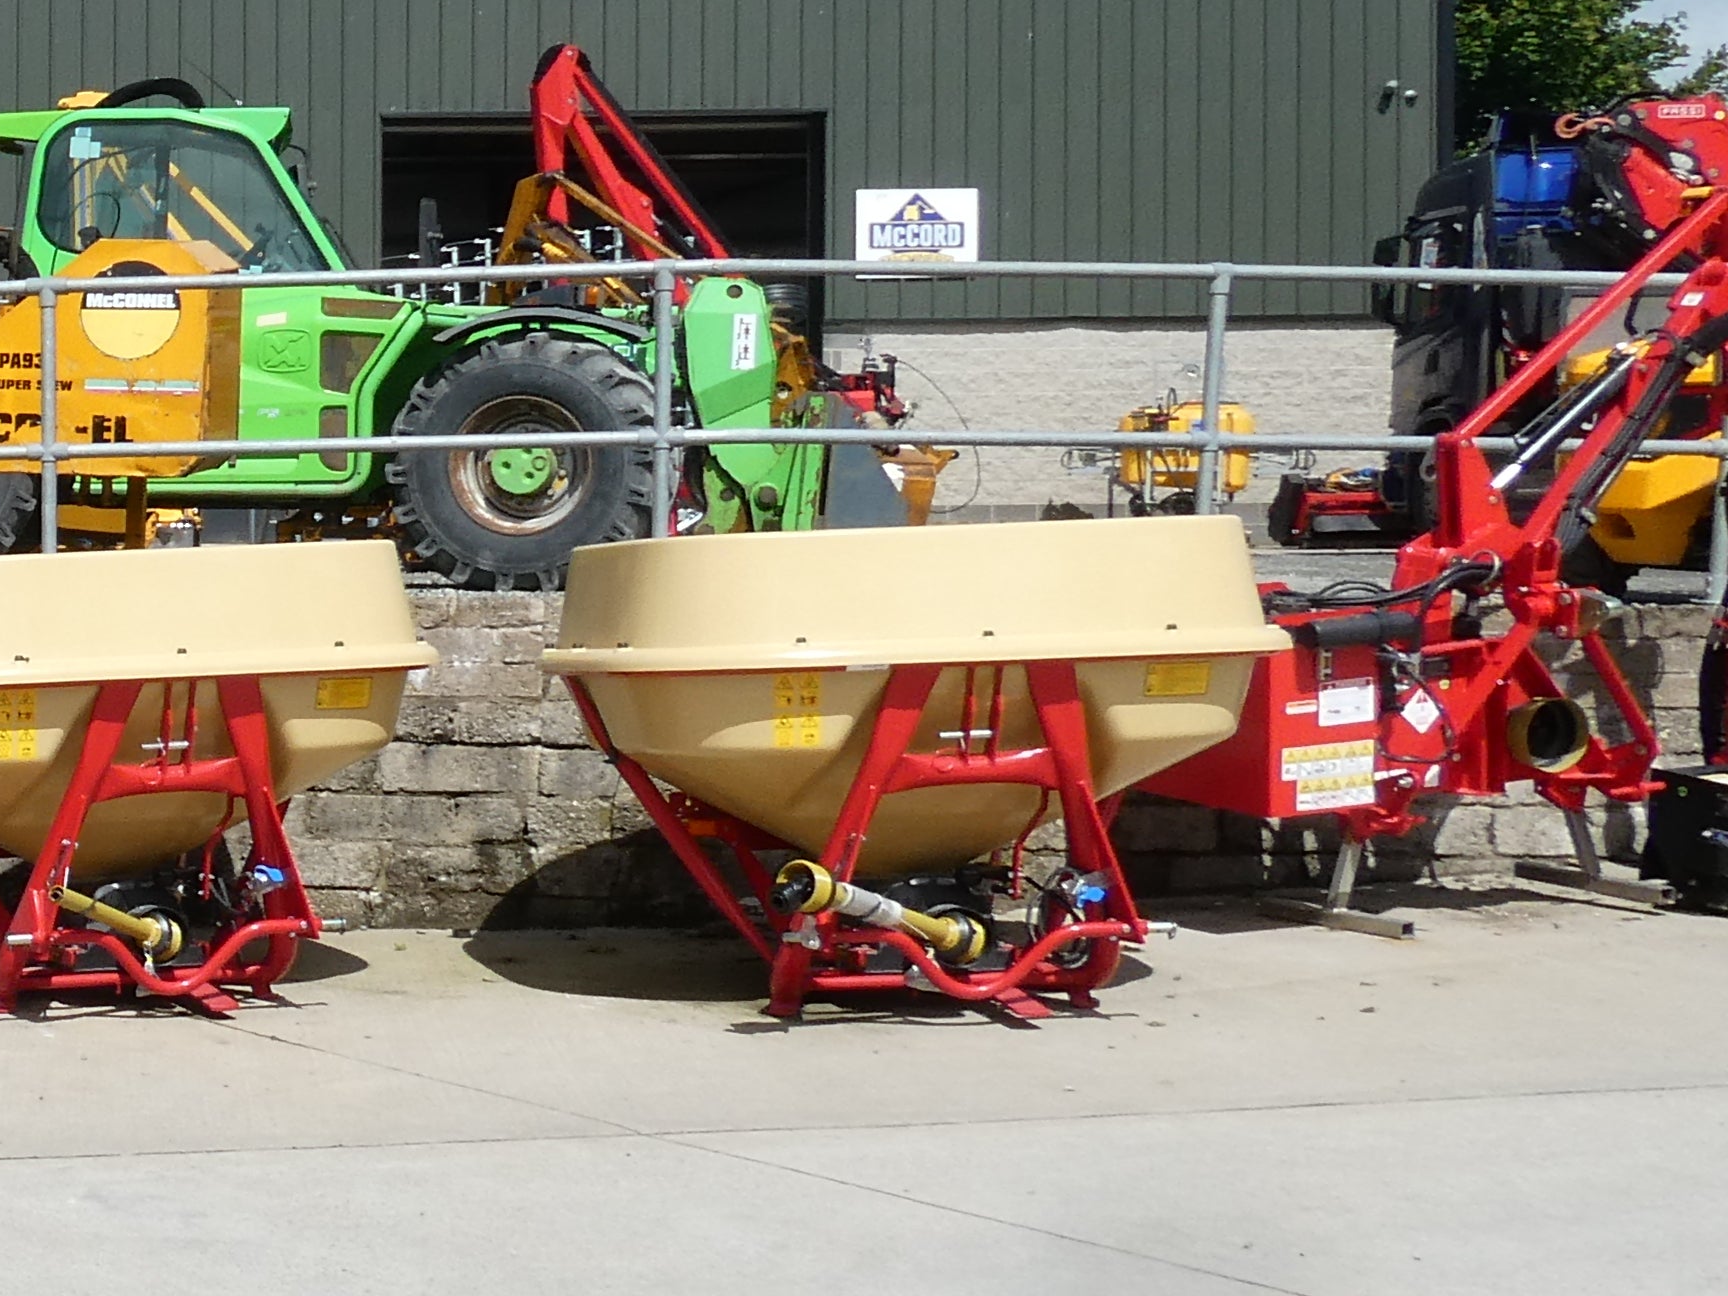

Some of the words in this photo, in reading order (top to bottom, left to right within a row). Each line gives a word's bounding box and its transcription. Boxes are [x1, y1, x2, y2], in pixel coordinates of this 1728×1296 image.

[872, 223, 962, 247] McCORD
[85, 292, 177, 309] McCONNEL
[36, 379, 73, 392] SEW
